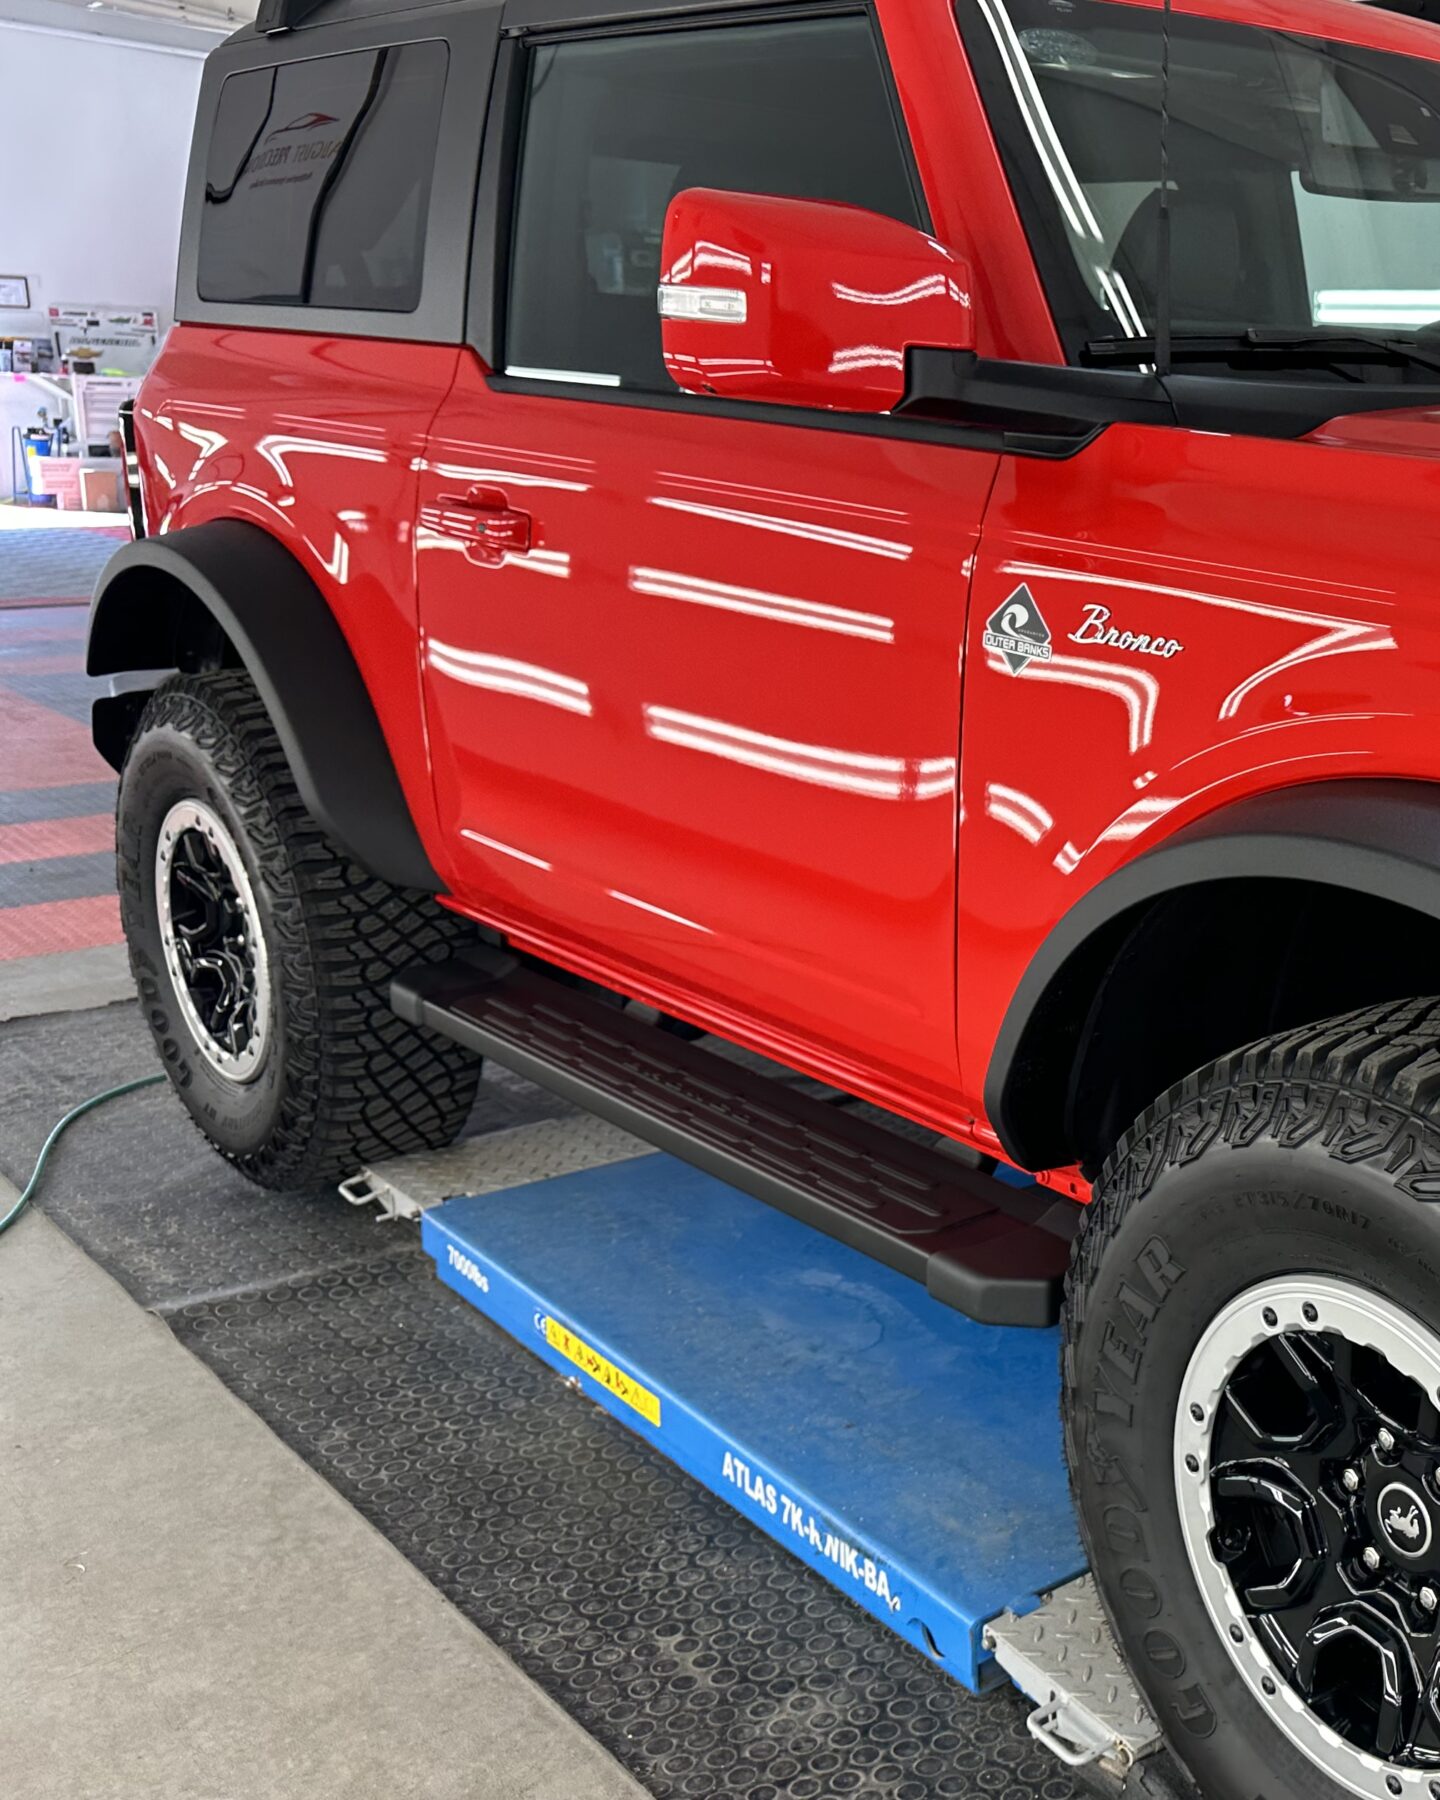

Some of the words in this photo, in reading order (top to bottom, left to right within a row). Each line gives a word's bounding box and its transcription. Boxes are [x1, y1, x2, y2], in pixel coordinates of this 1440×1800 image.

[985, 634, 1016, 651] OUTER
[1017, 641, 1049, 658] BANKS
[1067, 603, 1184, 658] Bronco
[722, 1451, 778, 1515] ATLAS
[1092, 1234, 1217, 1738] GOODYEAR
